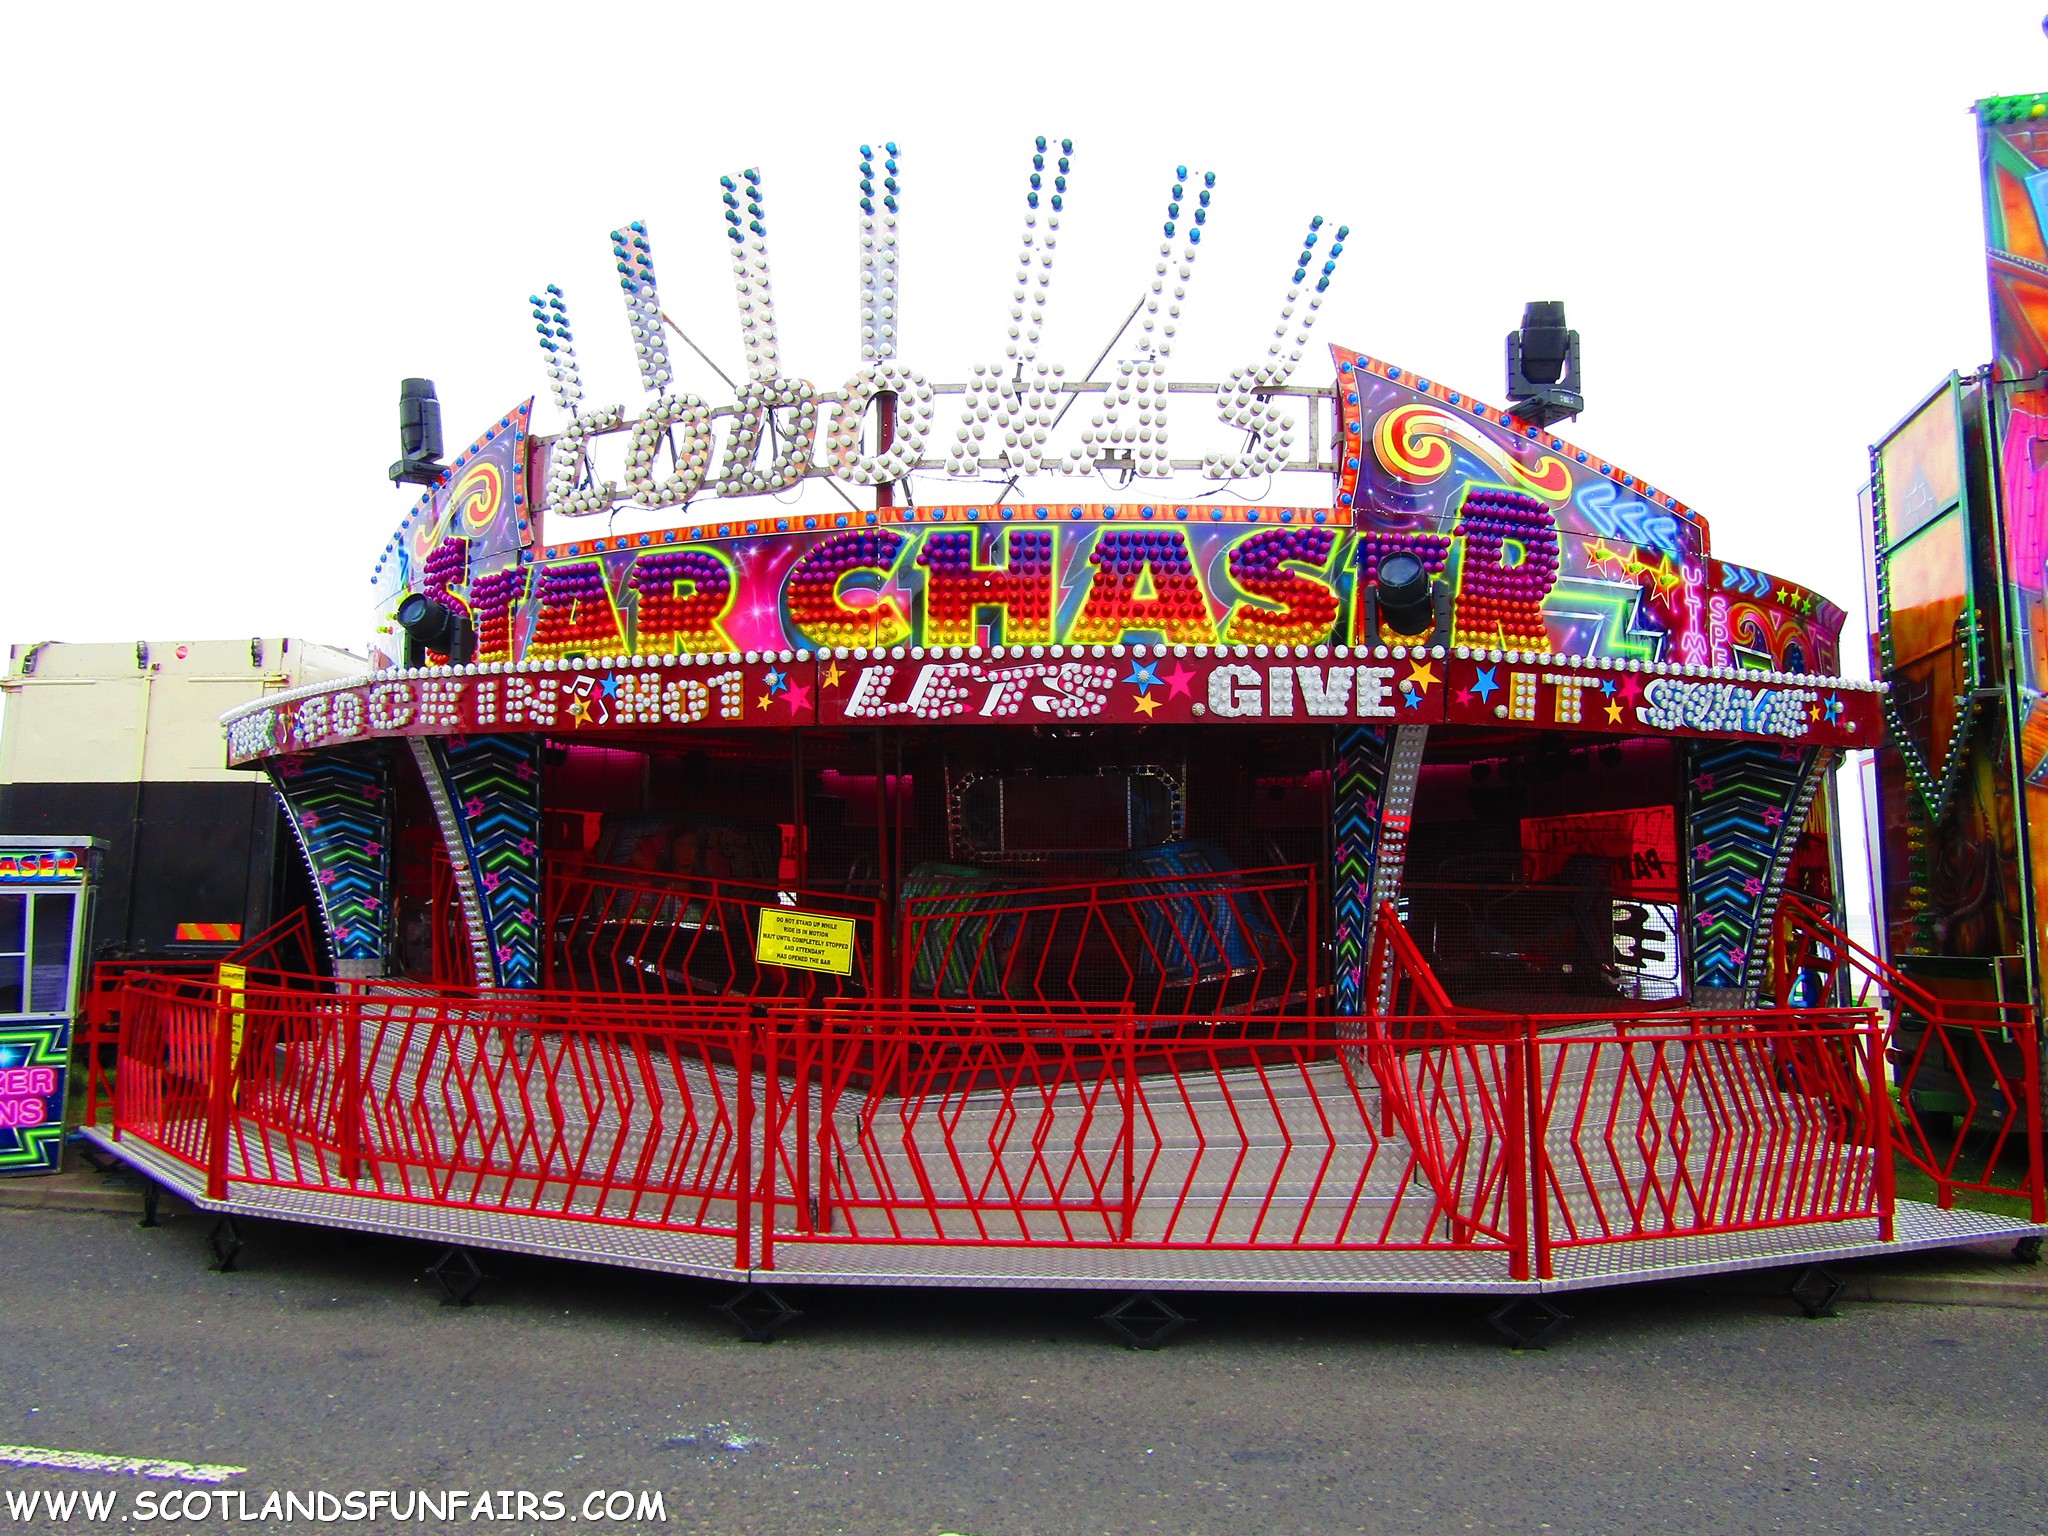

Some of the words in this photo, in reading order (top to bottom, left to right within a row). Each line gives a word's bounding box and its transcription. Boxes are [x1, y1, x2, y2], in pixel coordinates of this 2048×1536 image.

[844, 663, 1118, 719] LETS
[1207, 665, 1396, 718] GIVE
[1508, 672, 1600, 723] IT
[792, 937, 824, 946] COMPLETELY
[796, 947, 825, 955] ATTENDANT
